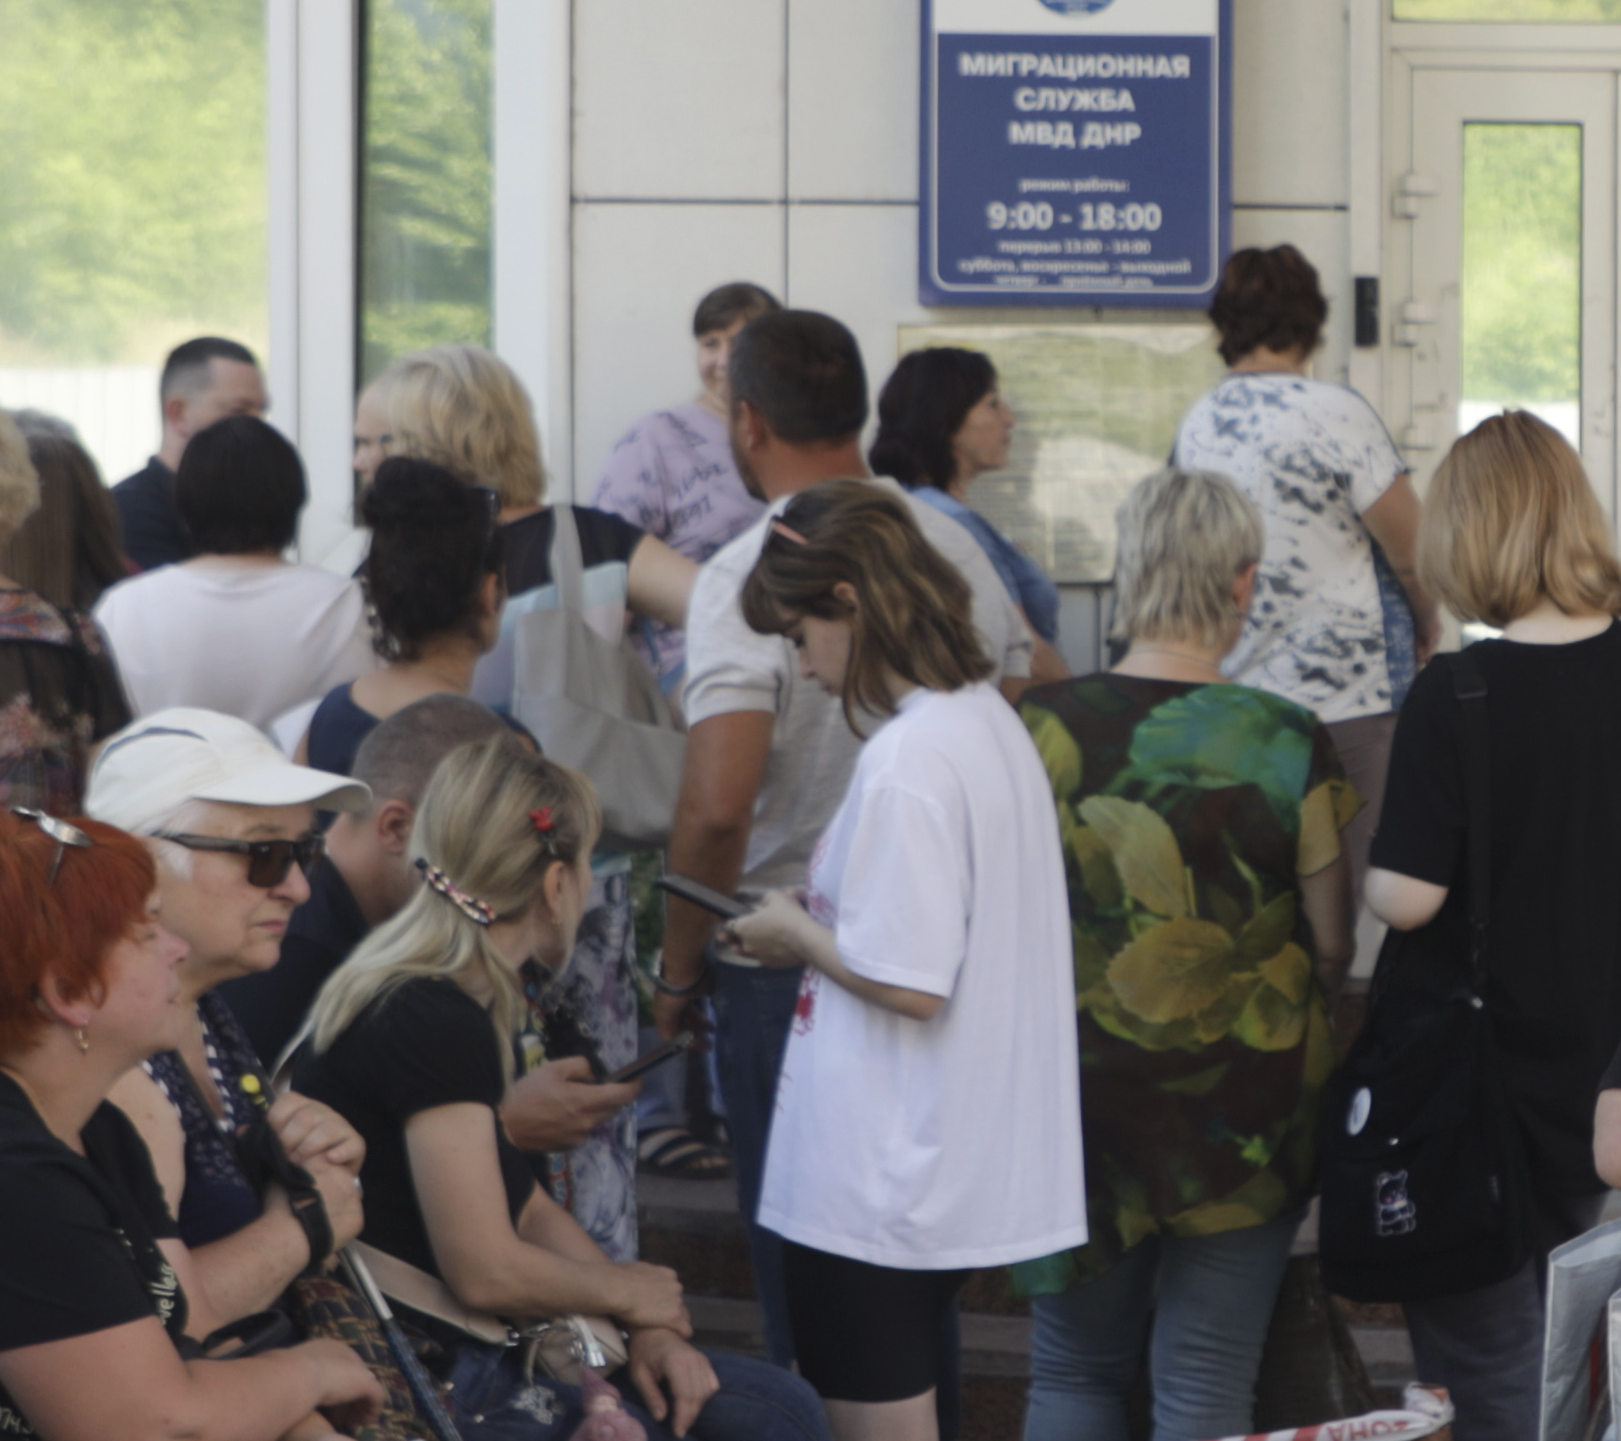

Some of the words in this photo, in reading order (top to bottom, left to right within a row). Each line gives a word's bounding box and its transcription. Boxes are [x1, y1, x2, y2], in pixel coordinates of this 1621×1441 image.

[959, 53, 1190, 80] МИГРАЦИОННАЯ
[1014, 88, 1136, 112] СЛУЖБА
[1009, 122, 1076, 149] МВД
[1082, 122, 1142, 149] ДНР
[986, 202, 1054, 230] 9:00
[1079, 202, 1163, 231] 18:00
